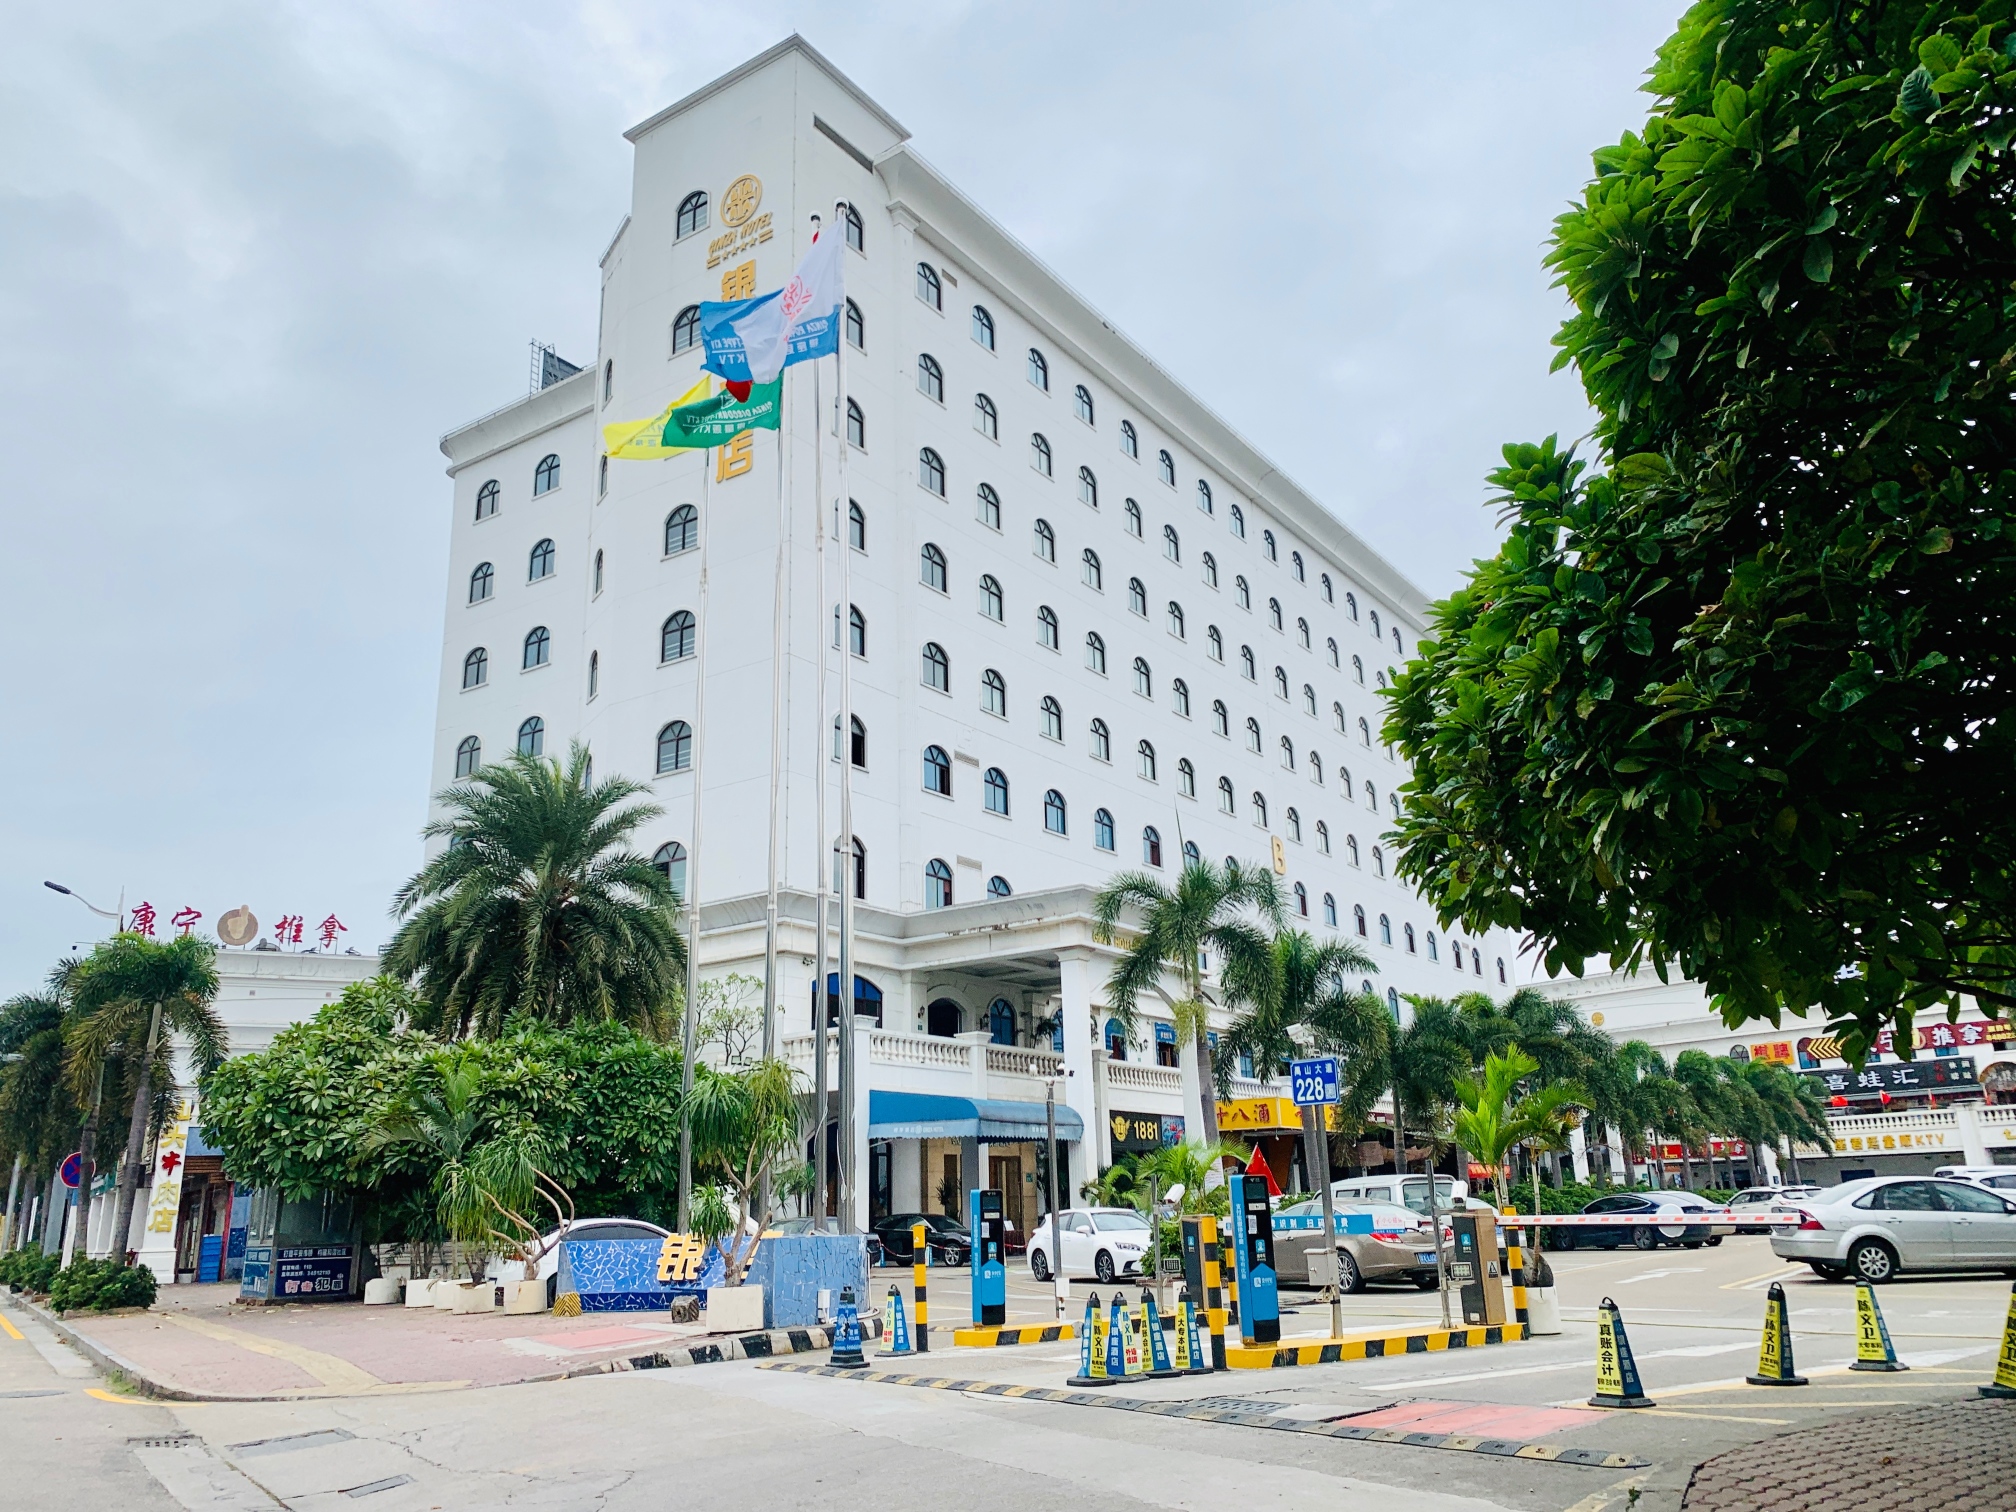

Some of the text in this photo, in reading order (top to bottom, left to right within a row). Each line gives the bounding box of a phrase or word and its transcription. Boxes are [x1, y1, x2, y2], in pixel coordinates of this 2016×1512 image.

[708, 212, 773, 258] GINZA HOTEL
[1271, 835, 1286, 875] B
[127, 901, 348, 949] 康宁 推拿
[1932, 1024, 1983, 1047] 推拿
[1296, 1077, 1324, 1102] 228
[1799, 1068, 1920, 1093] 喜蛙汇
[1134, 1120, 1159, 1140] 1881
[1857, 1299, 1876, 1340] 陈文卫
[1600, 1324, 1614, 1376] 真账会计
